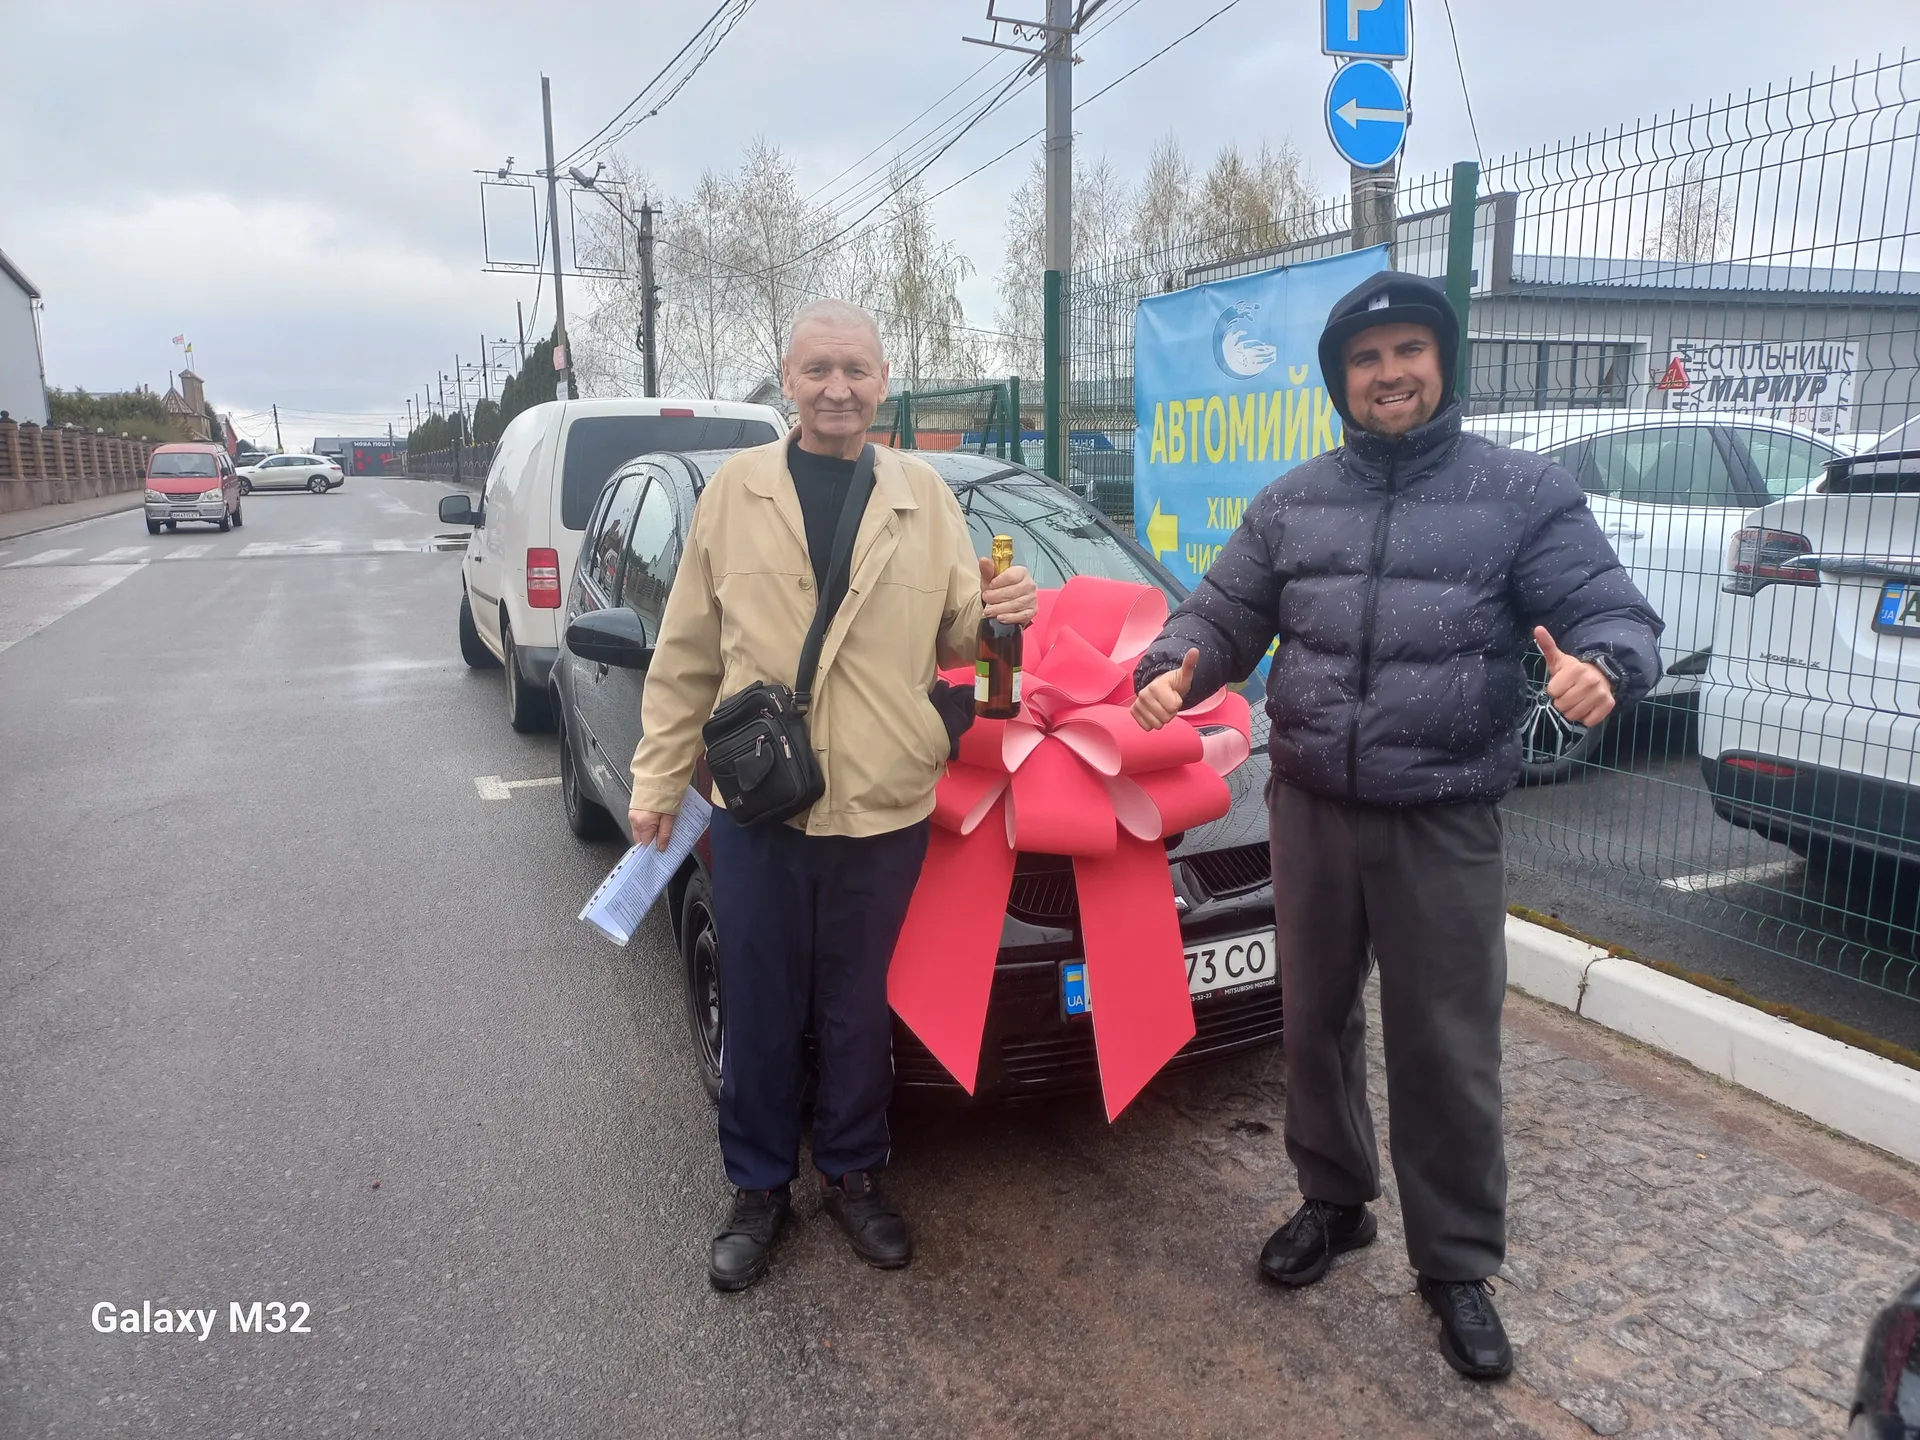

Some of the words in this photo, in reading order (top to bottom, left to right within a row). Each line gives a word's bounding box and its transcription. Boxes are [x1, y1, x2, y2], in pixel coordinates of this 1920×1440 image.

[1707, 375, 1828, 402] МАРМУР
[1150, 364, 1345, 464] АВТОМИЙК
[1760, 652, 1807, 666] MODEL
[1225, 940, 1266, 978] CO
[1224, 983, 1254, 996] MITSUBISHI
[1254, 978, 1276, 989] MOTORS
[1067, 995, 1084, 1007] UA
